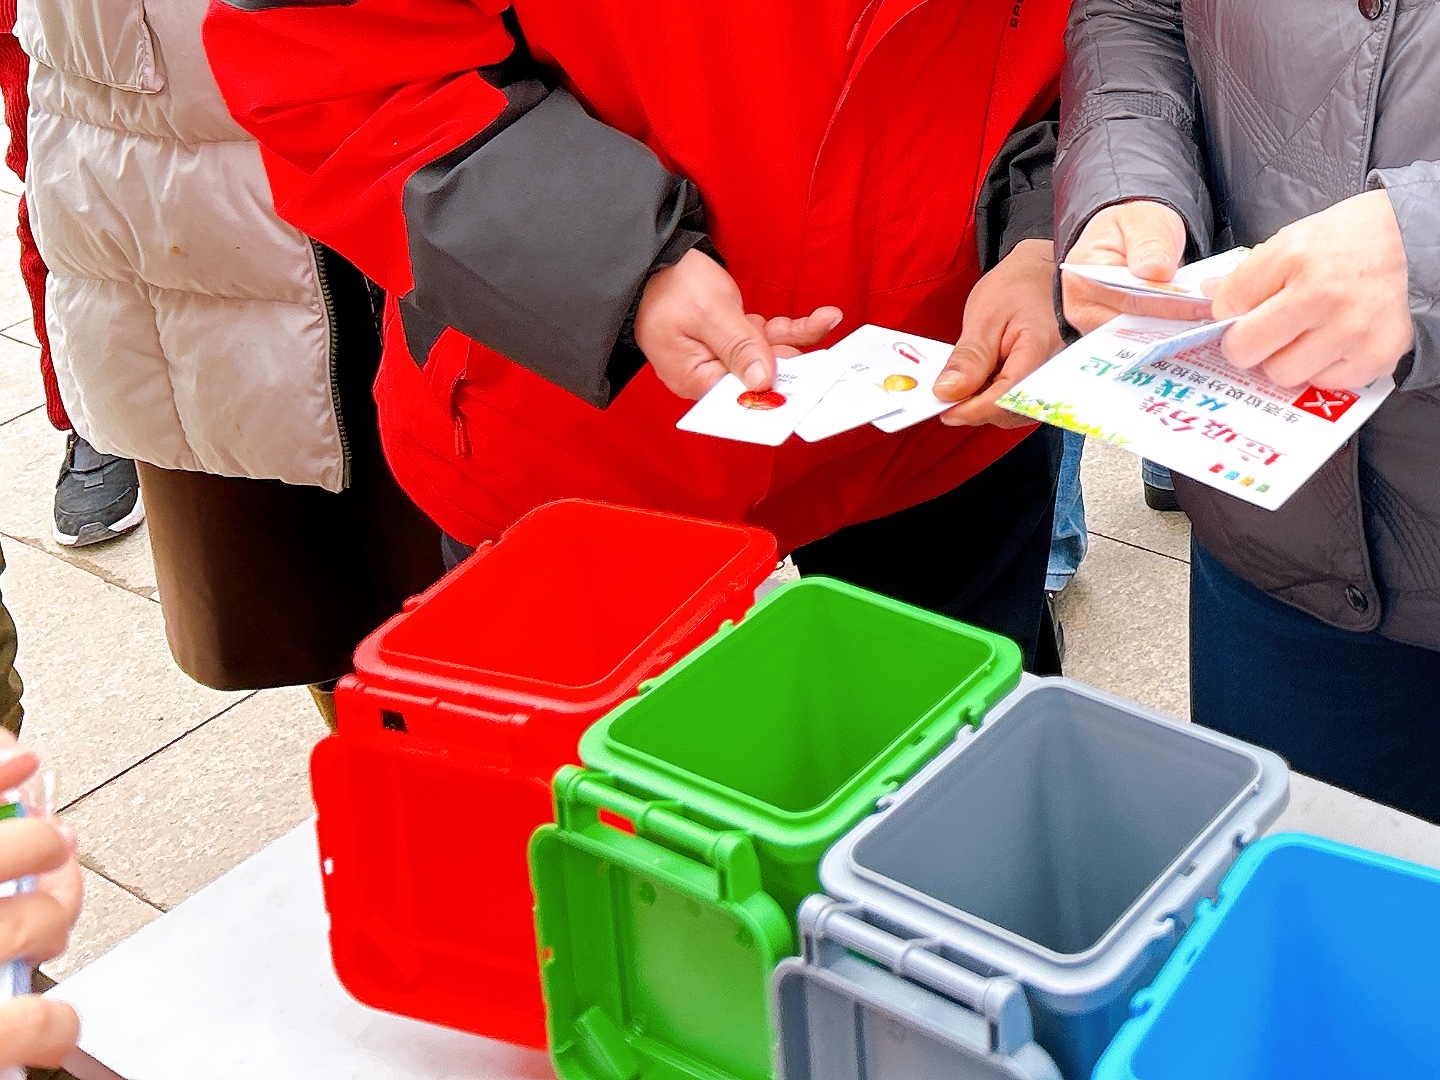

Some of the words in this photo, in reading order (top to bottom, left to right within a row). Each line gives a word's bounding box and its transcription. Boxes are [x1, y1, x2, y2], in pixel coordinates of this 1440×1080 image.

[1079, 355, 1228, 413] 从我做起
[1115, 349, 1302, 425] 生活垃圾分类投放南
[1138, 395, 1289, 467] 垃圾分类
